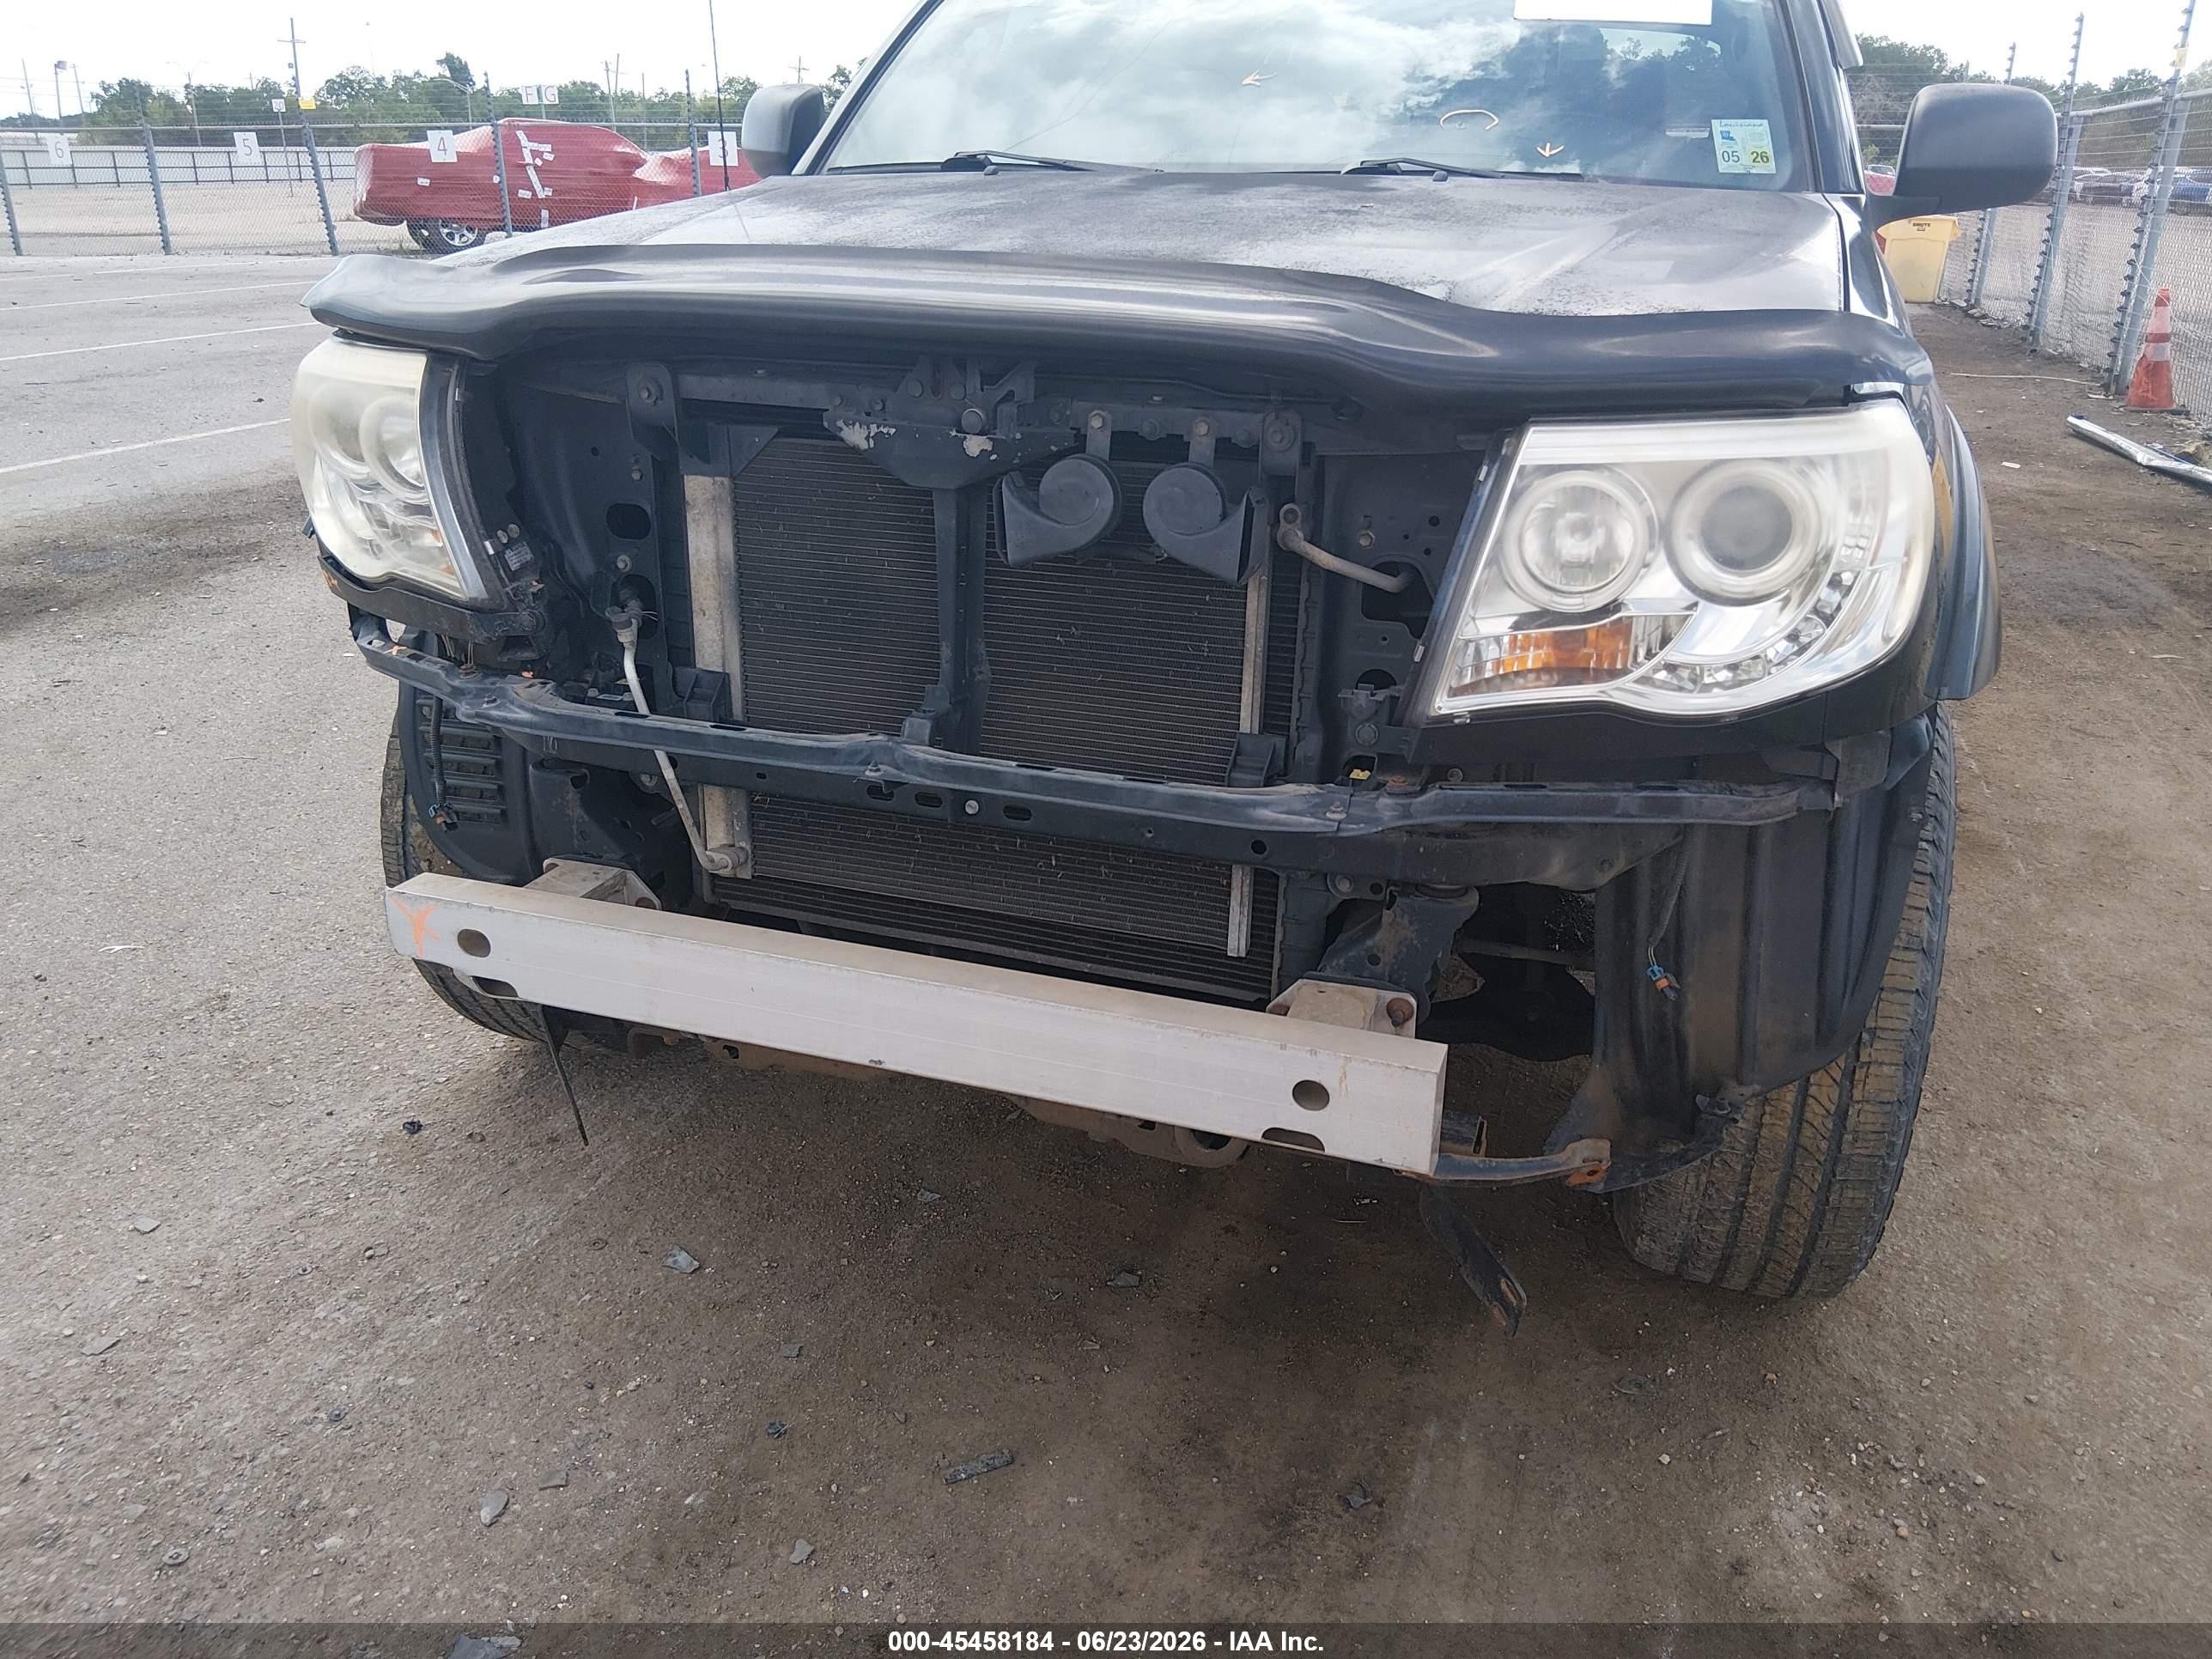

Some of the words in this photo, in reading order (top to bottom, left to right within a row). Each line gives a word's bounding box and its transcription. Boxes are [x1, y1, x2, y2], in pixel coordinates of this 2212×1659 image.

[525, 86, 533, 103] F
[544, 85, 556, 102] G
[55, 141, 64, 159] 6
[243, 138, 252, 156] 5
[437, 137, 448, 156] 4
[718, 138, 729, 159] 3
[1722, 150, 1740, 163] 05
[1750, 150, 1770, 164] 26
